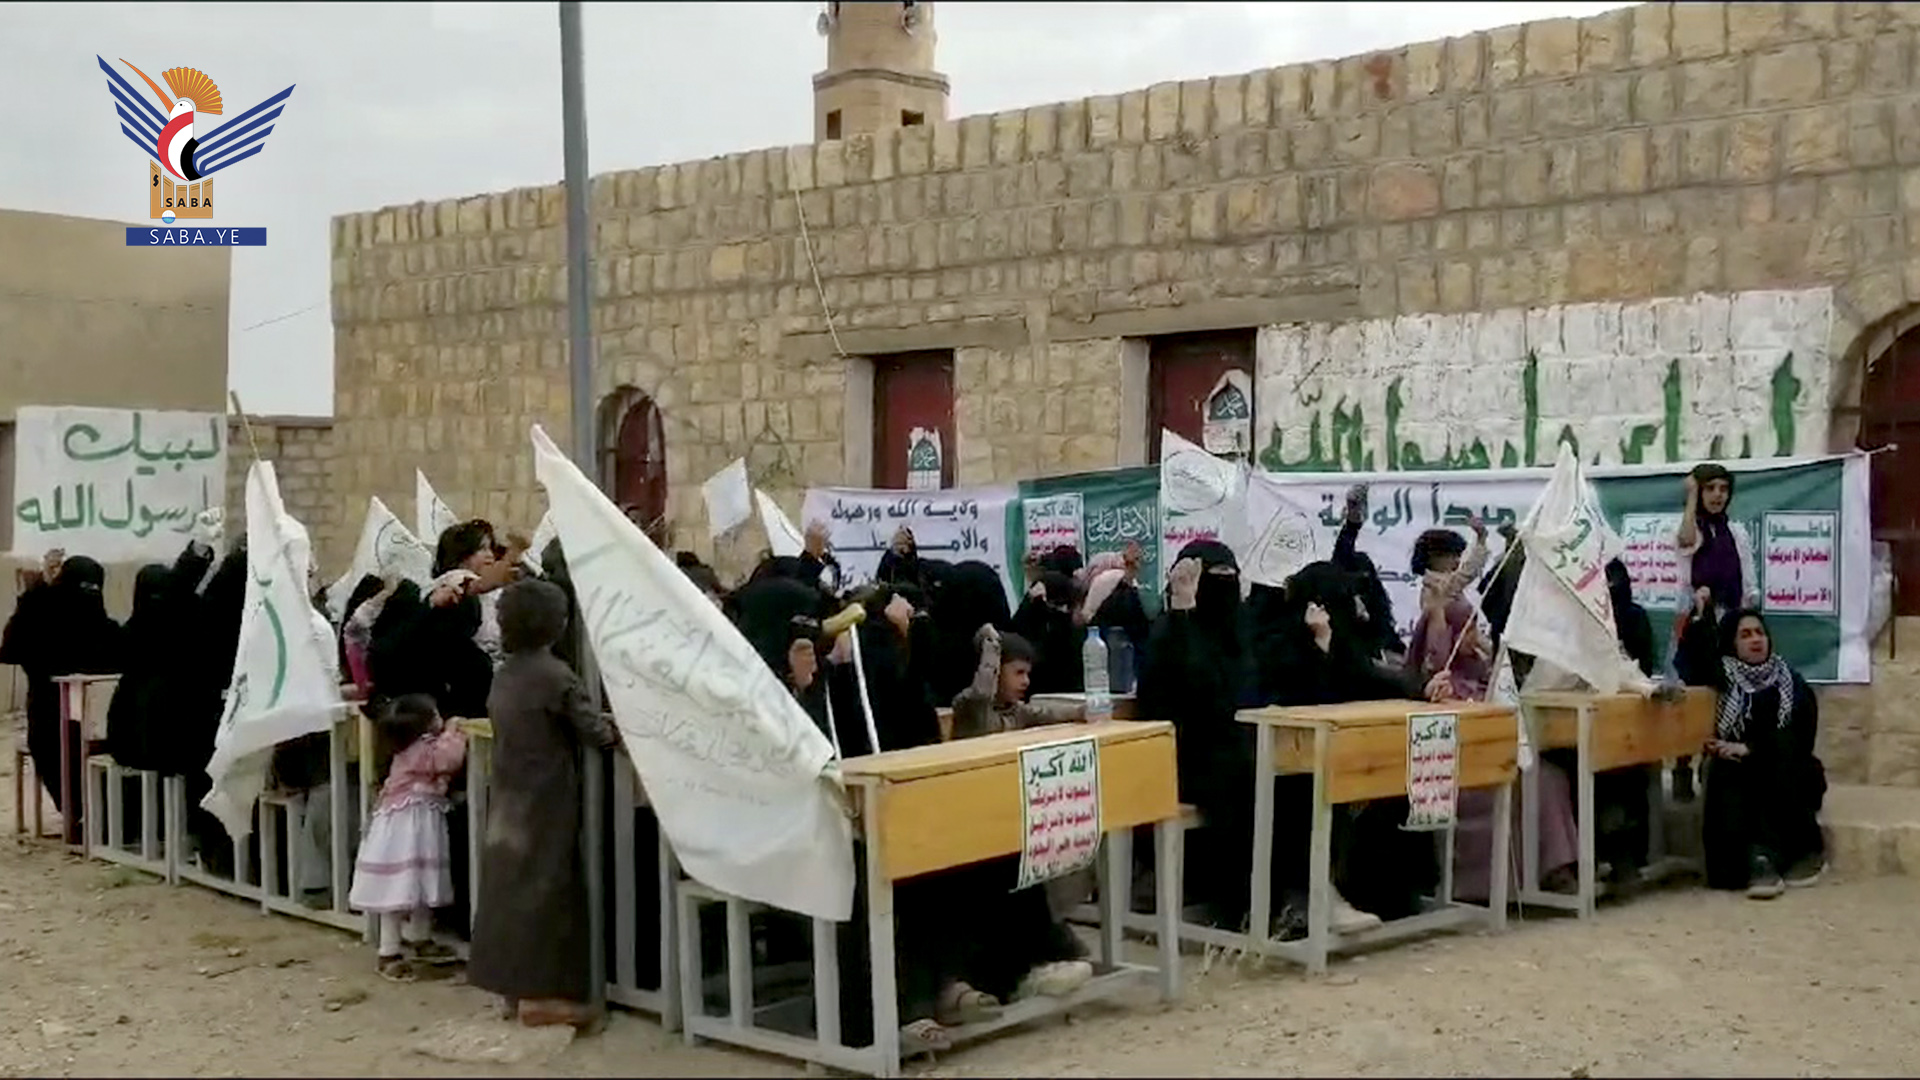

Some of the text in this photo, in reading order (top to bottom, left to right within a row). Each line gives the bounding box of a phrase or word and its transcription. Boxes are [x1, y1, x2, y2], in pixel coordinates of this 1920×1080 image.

[64, 412, 221, 475] لبيك
[17, 483, 94, 532] الله
[98, 478, 200, 538] رسول
[1069, 749, 1093, 774] الله
